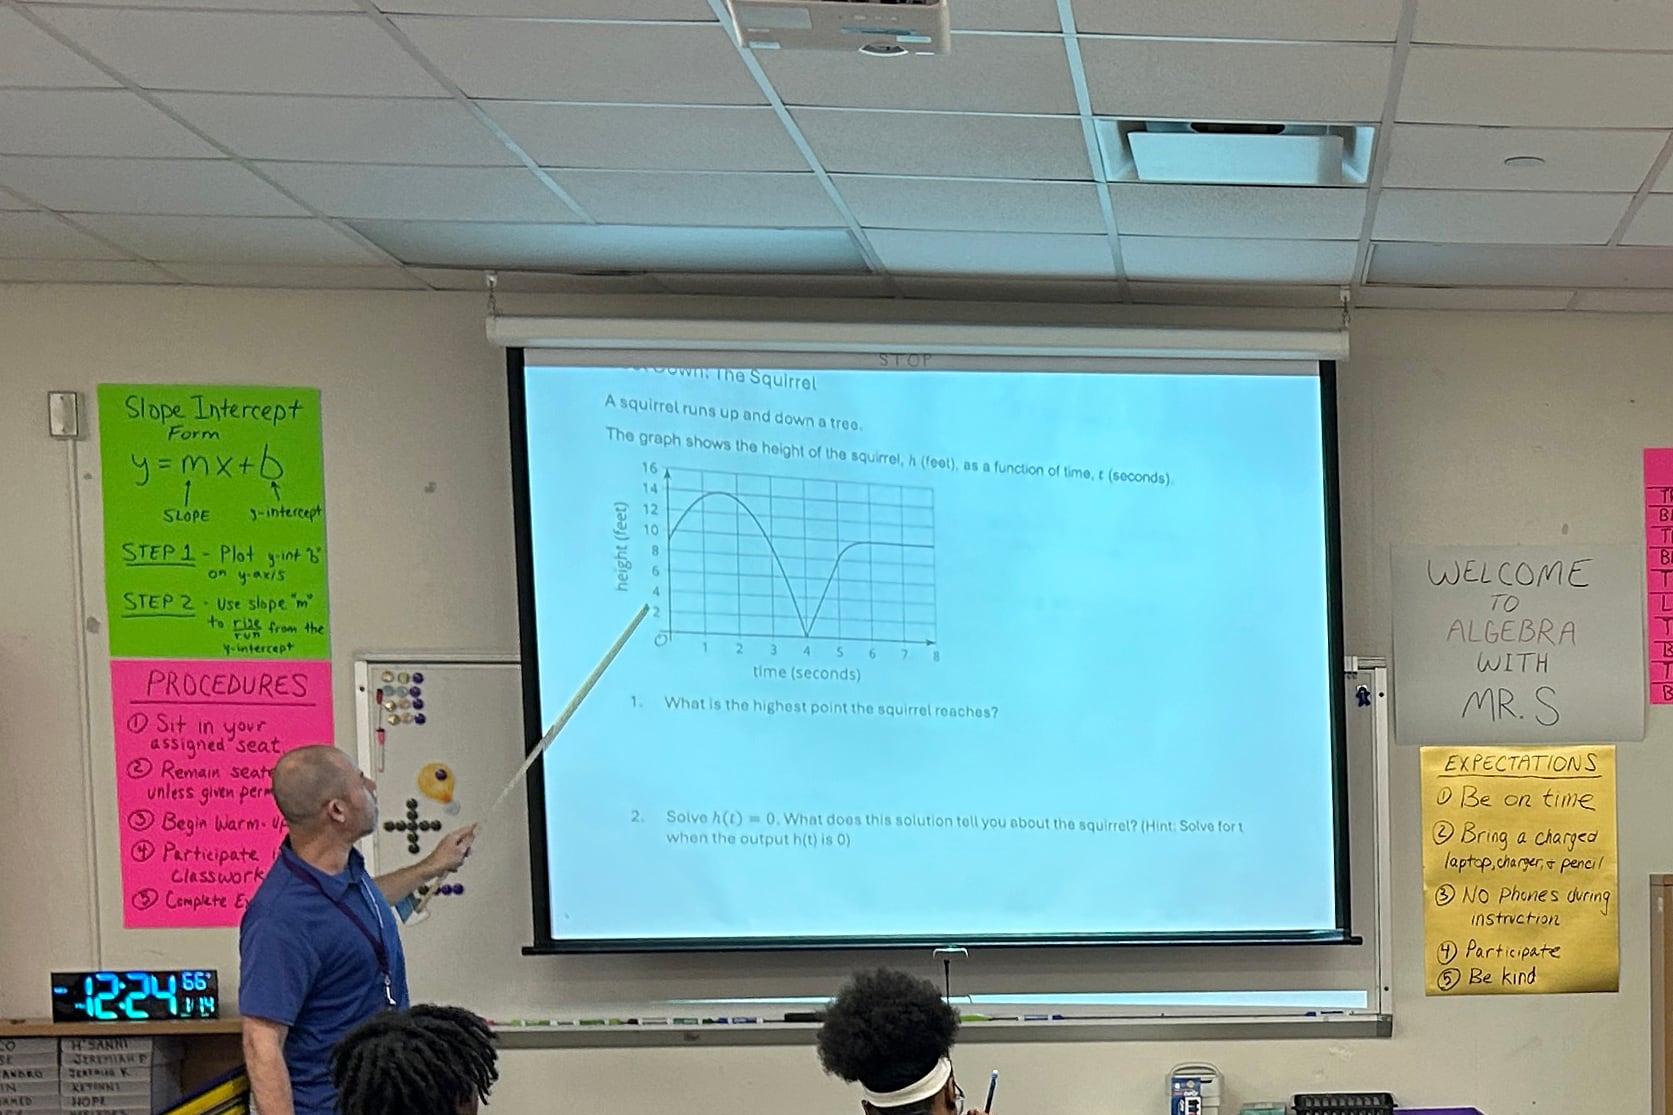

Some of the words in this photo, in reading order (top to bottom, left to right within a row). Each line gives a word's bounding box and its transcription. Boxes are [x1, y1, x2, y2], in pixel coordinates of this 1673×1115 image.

[879, 353, 933, 368] STOP
[750, 371, 817, 391] Squirrel
[125, 395, 185, 424] Slope
[191, 395, 303, 426] Intercept
[604, 395, 616, 407] A
[620, 397, 678, 415] squirrel
[683, 404, 715, 419] runs
[720, 407, 739, 423] up
[743, 409, 771, 423] and
[775, 412, 814, 427] down
[168, 426, 220, 441] Form
[607, 427, 634, 442] The
[639, 431, 681, 448] graph
[686, 435, 731, 451] shows
[736, 439, 758, 453] the
[762, 442, 804, 459] height
[809, 446, 822, 459] of
[826, 447, 847, 461] the
[964, 461, 978, 471] as
[995, 461, 1043, 476] function
[1048, 465, 1060, 476] of
[163, 509, 210, 523] SLOPE
[122, 543, 175, 561] STEP
[183, 543, 192, 561] 1
[220, 544, 254, 563] Plot
[208, 569, 226, 579] on
[614, 546, 632, 591] height
[1427, 559, 1594, 587] WELCOME
[123, 593, 173, 611] STEP
[182, 595, 195, 610] 2
[217, 598, 241, 611] Use
[248, 598, 287, 613] slope
[1491, 594, 1519, 612] TO
[1447, 618, 1576, 646] ALGEBRA
[1477, 652, 1548, 673] WITH
[147, 669, 308, 698] PROCEDURES
[754, 666, 787, 679] time
[791, 667, 861, 682] (seconds)
[665, 696, 705, 710] What
[709, 697, 721, 710] is
[726, 698, 749, 711] the
[754, 700, 806, 715] highest
[811, 701, 848, 715] point
[852, 702, 874, 715] the
[878, 703, 932, 718] squirrel
[935, 706, 999, 719] reaches?
[1535, 686, 1559, 726] S
[157, 713, 186, 733] Sit
[199, 717, 213, 734] in
[224, 721, 267, 742] your
[150, 738, 225, 759] assigned
[161, 760, 220, 778] Remain
[1445, 752, 1599, 772] EXPECTATIONS
[148, 784, 193, 800] unless
[201, 787, 234, 805] given
[1461, 786, 1491, 808] Be
[1505, 796, 1531, 807] on
[1544, 788, 1595, 811] time
[162, 811, 206, 837] Begin
[666, 811, 708, 824] Solve
[784, 813, 823, 826] What
[826, 814, 861, 826] does
[866, 814, 891, 826] this
[895, 814, 952, 828] solution
[957, 816, 978, 828] tell
[982, 818, 1006, 830] you
[1010, 817, 1050, 830] about
[1054, 818, 1075, 830] the
[1079, 819, 1137, 834] squirrel?
[1180, 820, 1215, 832] Solve
[1218, 820, 1237, 832] for
[666, 833, 708, 845] when
[713, 833, 735, 845] the
[740, 834, 789, 847] output
[793, 834, 817, 848] h(t)
[822, 834, 833, 846] is
[837, 834, 851, 848] 0)
[1461, 821, 1508, 850] Bring
[1518, 833, 1526, 844] a
[1535, 829, 1598, 852] charged
[162, 842, 259, 865] Participate
[1561, 856, 1604, 874] pencil
[165, 891, 227, 910] Complete
[1567, 888, 1610, 916] during
[1472, 912, 1560, 926] instruction
[1466, 939, 1561, 960] Participate
[1469, 968, 1491, 985] Be
[1502, 966, 1536, 986] kind
